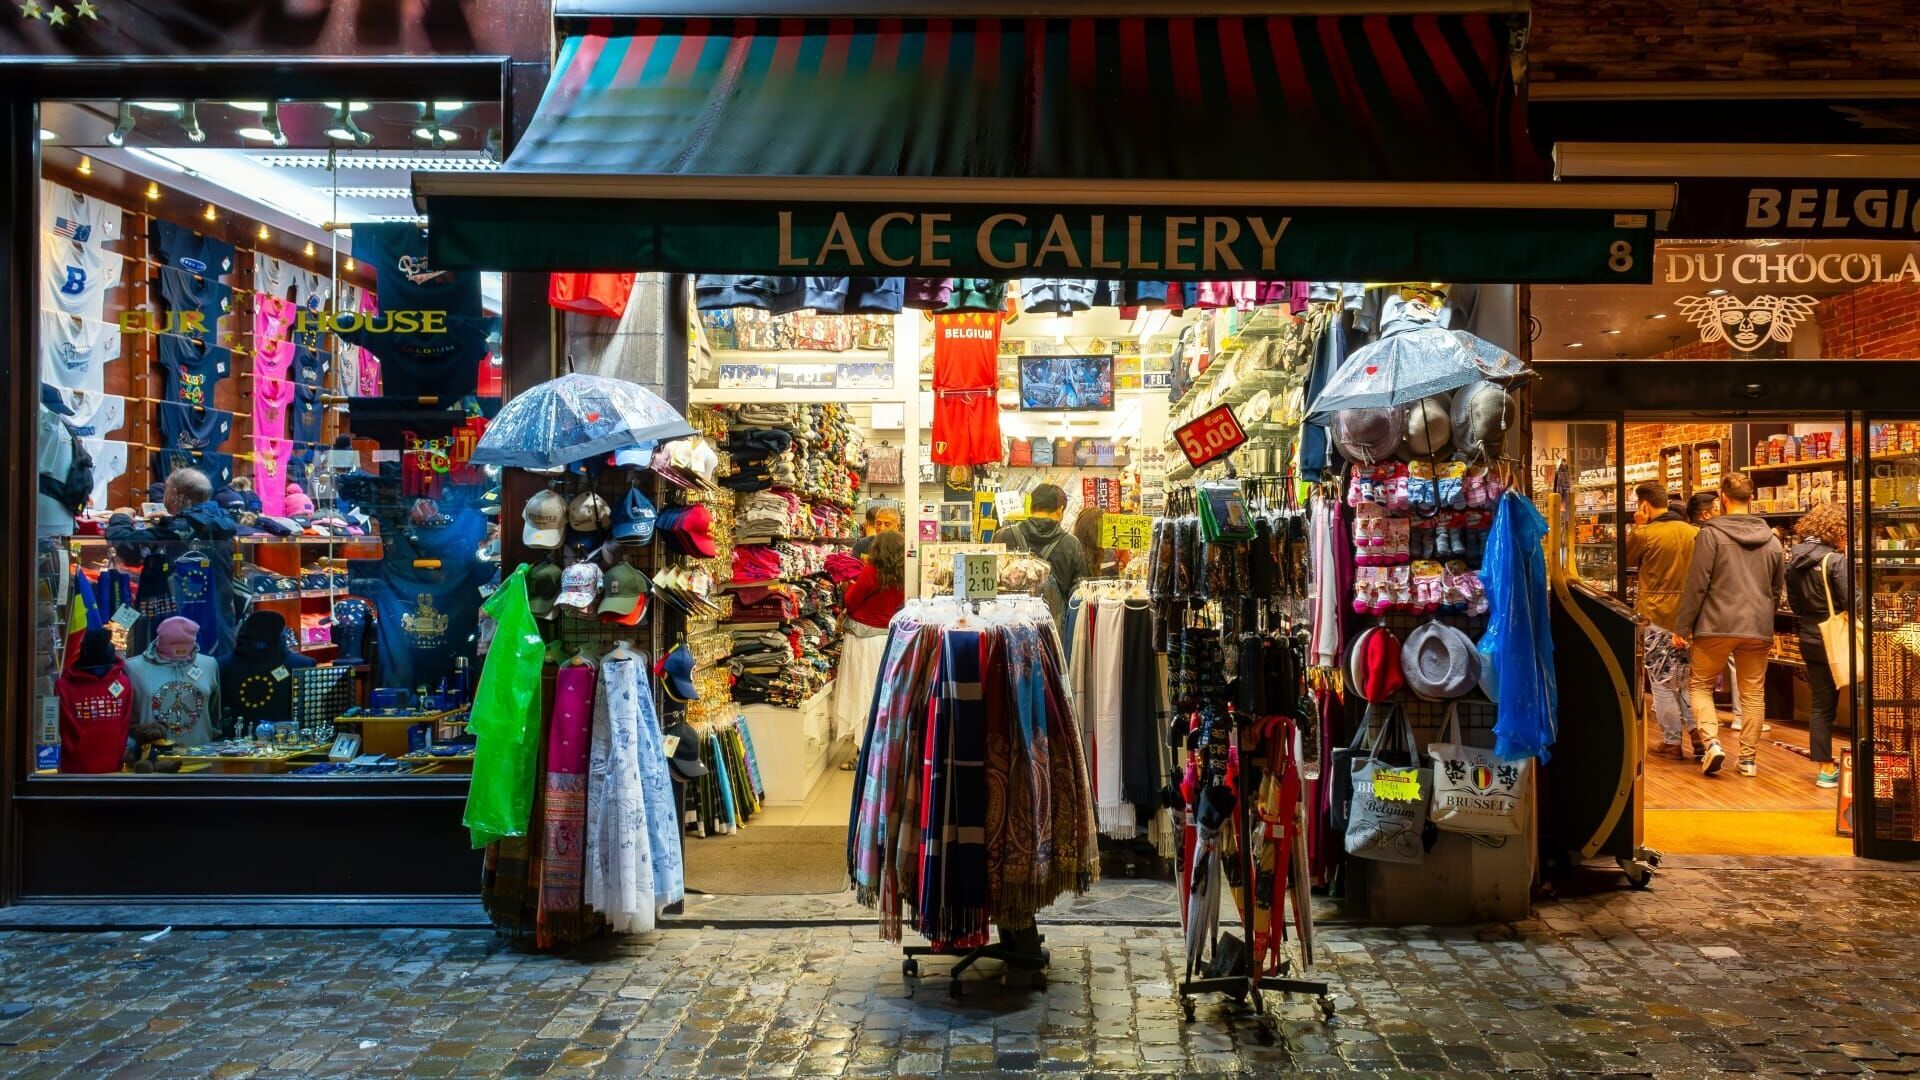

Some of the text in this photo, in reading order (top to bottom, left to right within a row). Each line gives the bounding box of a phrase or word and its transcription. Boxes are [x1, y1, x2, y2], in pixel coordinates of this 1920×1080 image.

[777, 210, 1292, 271] LACE GALLERY
[1608, 240, 1634, 272] 8
[1666, 253, 1920, 284] DU CHOCOLA
[61, 265, 87, 295] B
[296, 310, 447, 334] HOUSE
[943, 327, 993, 340] BELGIUM
[1150, 374, 1167, 386] FBI
[1204, 411, 1225, 427] Euro
[1181, 420, 1237, 460] 5,00
[1580, 447, 1605, 461] DU
[1364, 800, 1416, 817] Belgium
[1446, 795, 1516, 811] BRUSSELS
